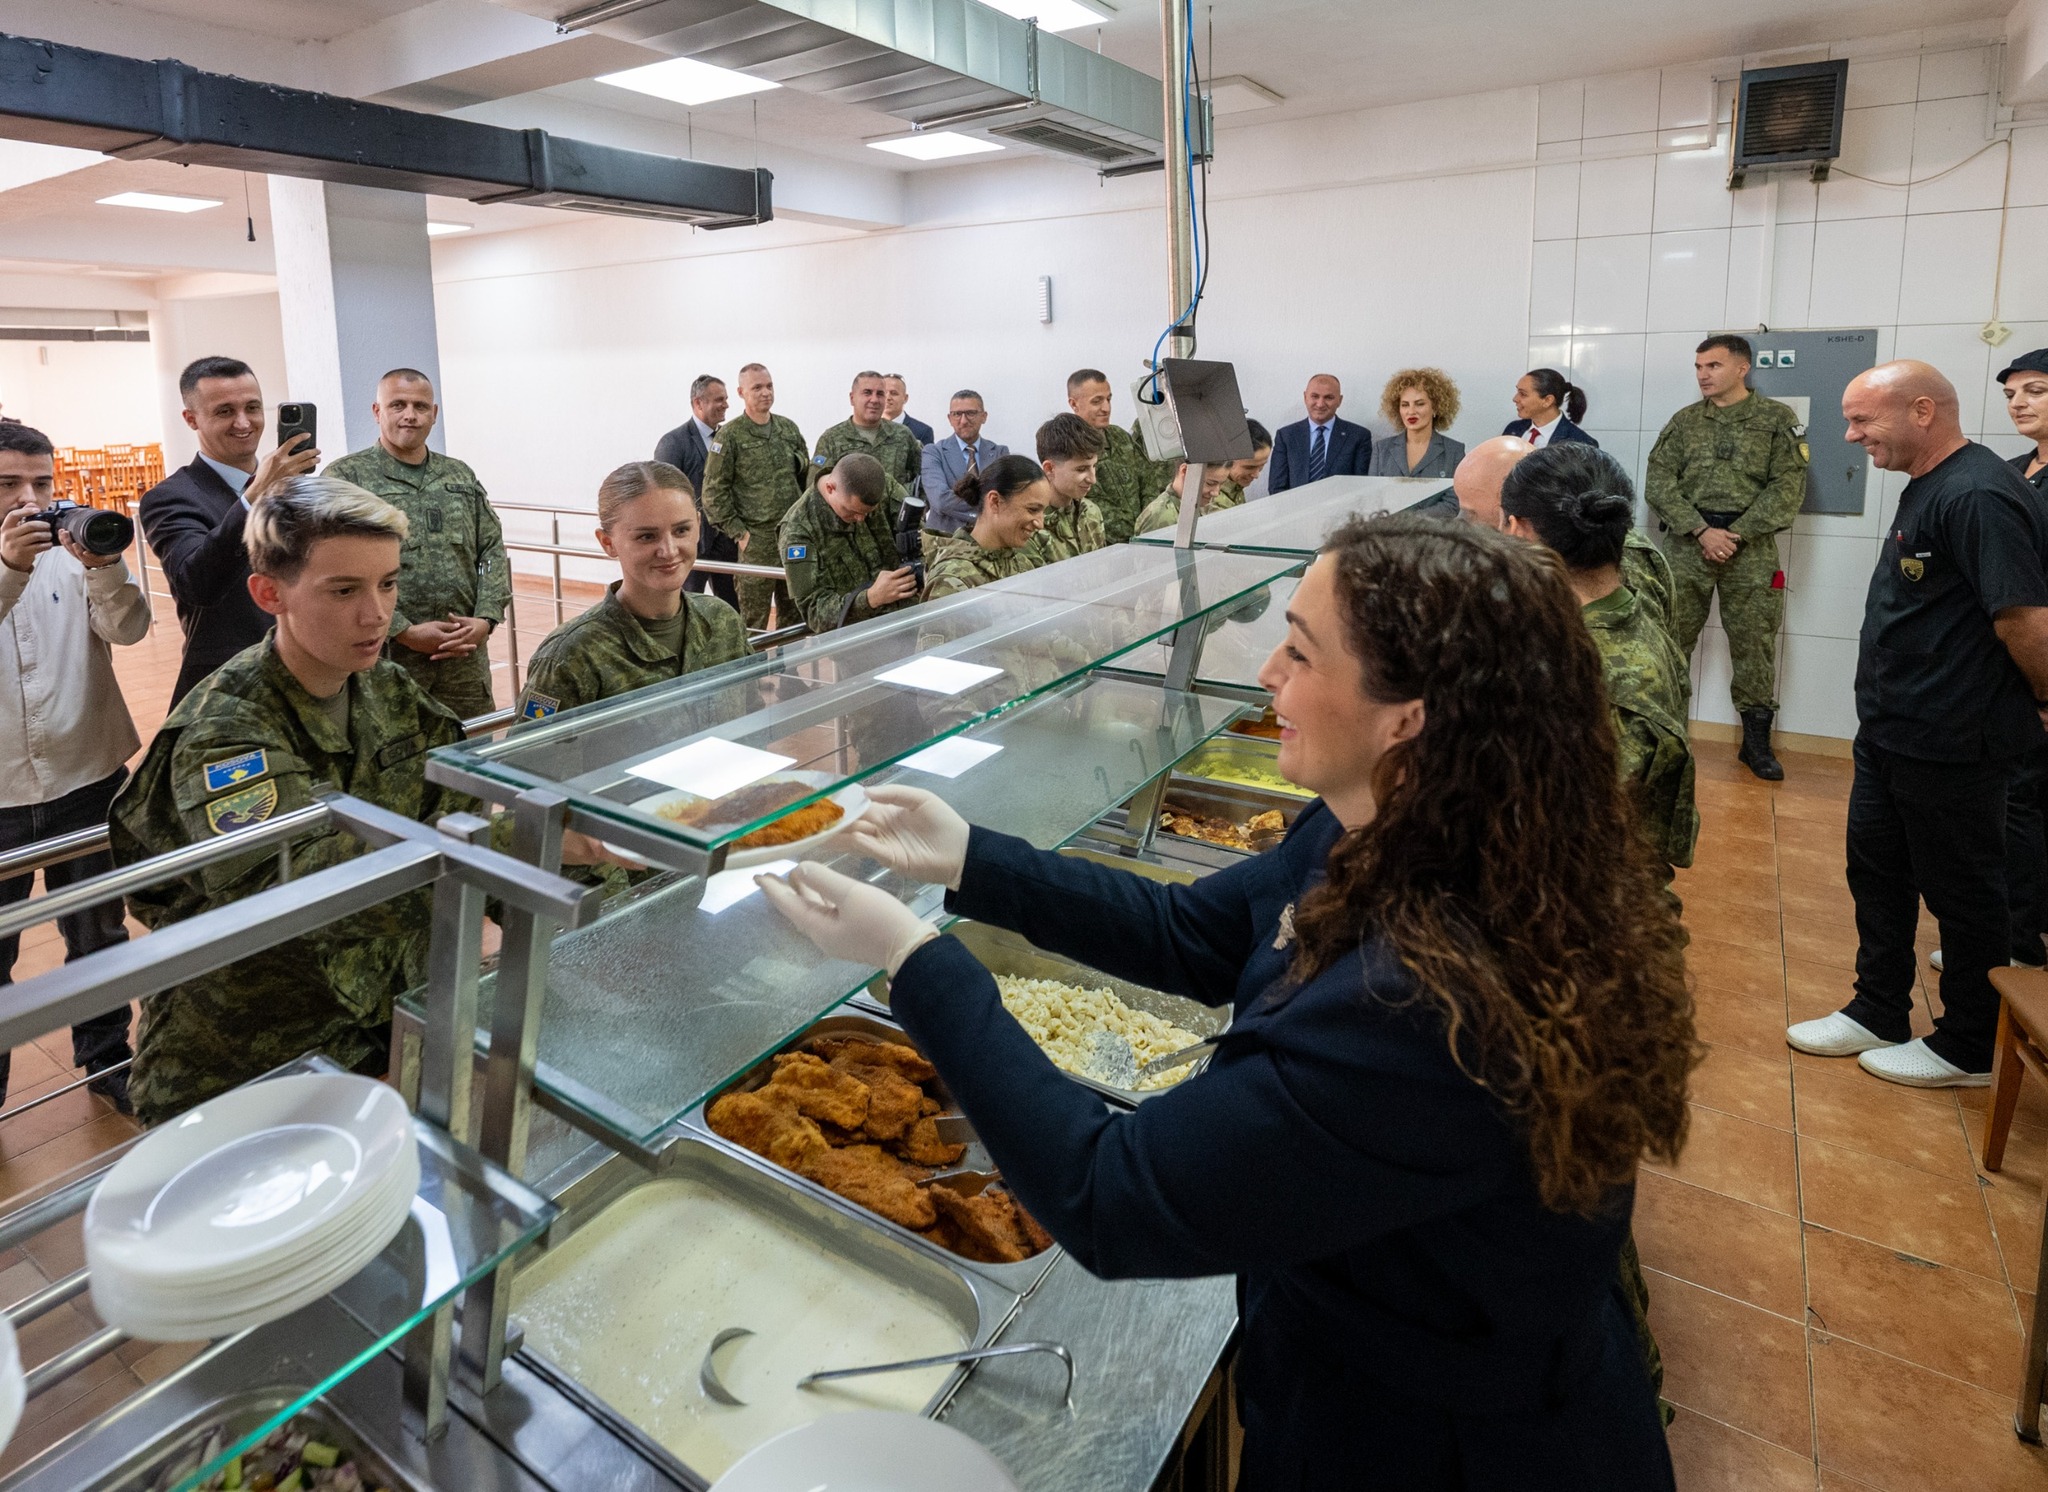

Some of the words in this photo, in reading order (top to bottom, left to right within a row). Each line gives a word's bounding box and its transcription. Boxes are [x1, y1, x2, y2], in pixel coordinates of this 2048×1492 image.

[1827, 334, 1865, 343] KSHE-D
[529, 693, 557, 707] KOSOVA
[214, 753, 256, 770] KOSOVA
